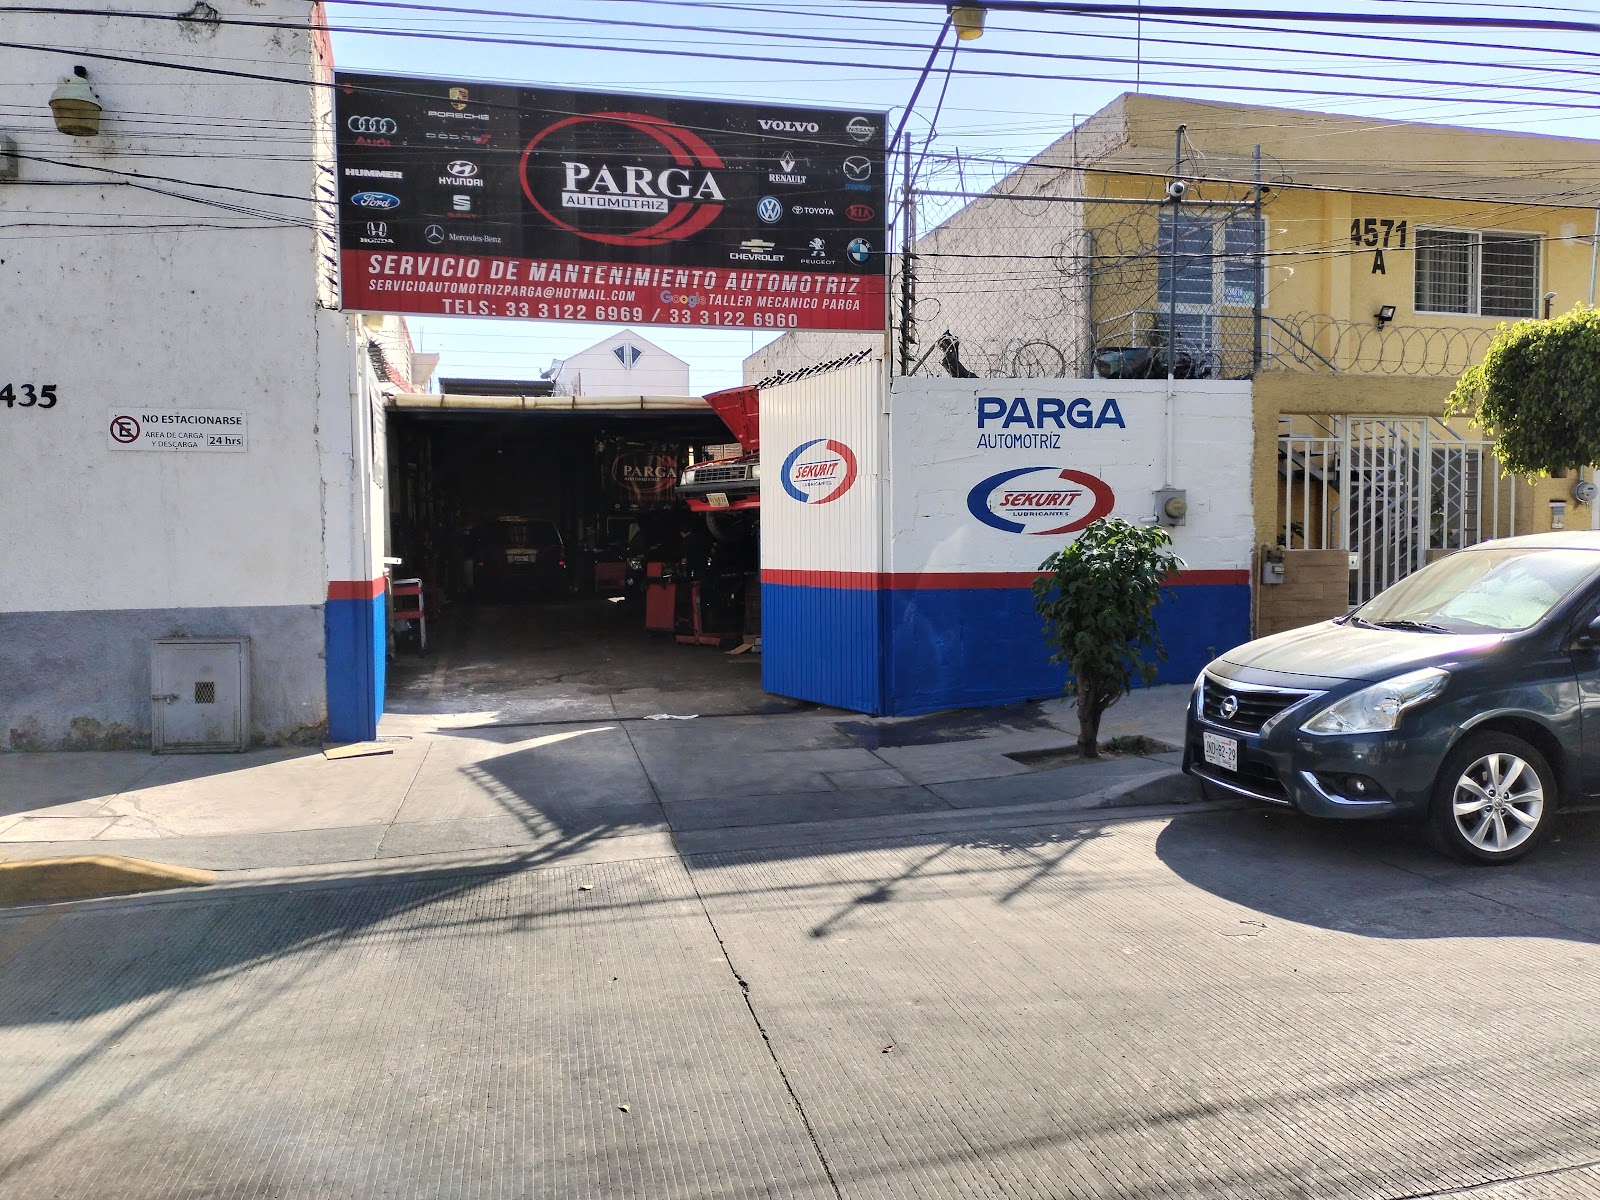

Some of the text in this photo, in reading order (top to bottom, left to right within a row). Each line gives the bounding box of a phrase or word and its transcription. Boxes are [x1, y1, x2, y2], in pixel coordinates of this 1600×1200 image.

[428, 110, 489, 121] PORSCHE
[758, 119, 819, 133] VOLVO
[345, 168, 403, 179] HUMMER
[769, 173, 807, 184] RENAULT
[439, 176, 483, 187] HYUNDAI
[561, 161, 726, 200] PARGA
[360, 193, 391, 208] Ford
[566, 195, 666, 211] AUTOMOTRIZ
[804, 206, 834, 215] TOYOTA
[850, 208, 870, 218] KIA
[449, 233, 501, 243] Mercedes-Benz
[1351, 218, 1407, 248] 4571
[729, 252, 785, 262] CHEVROLET
[1371, 248, 1386, 274] A
[368, 254, 860, 295] SERVICIO DE MANTENIMIENTO AUTOMOTRIZ
[368, 279, 636, 302] SERVICIOAUTOMOTRIZPARGA@HOTMAIL.COM
[660, 289, 860, 311] Google TALLER MECANICO PARGA
[442, 298, 496, 316] TELS:
[505, 301, 529, 317] 33
[538, 303, 587, 320] 3122
[595, 305, 643, 322] 6969
[669, 309, 691, 324] 33
[700, 310, 745, 326] 3122
[753, 312, 798, 328] 6960
[142, 414, 242, 425] NO ESTACIONARSE
[977, 397, 1126, 429] PARGA
[166, 431, 177, 439] DE
[209, 436, 242, 445] 24 hrs
[158, 440, 198, 448] DESCARGA
[623, 465, 677, 478] PARGA
[795, 462, 839, 479] SEKURIT
[1000, 493, 1081, 507] SEKURIT
